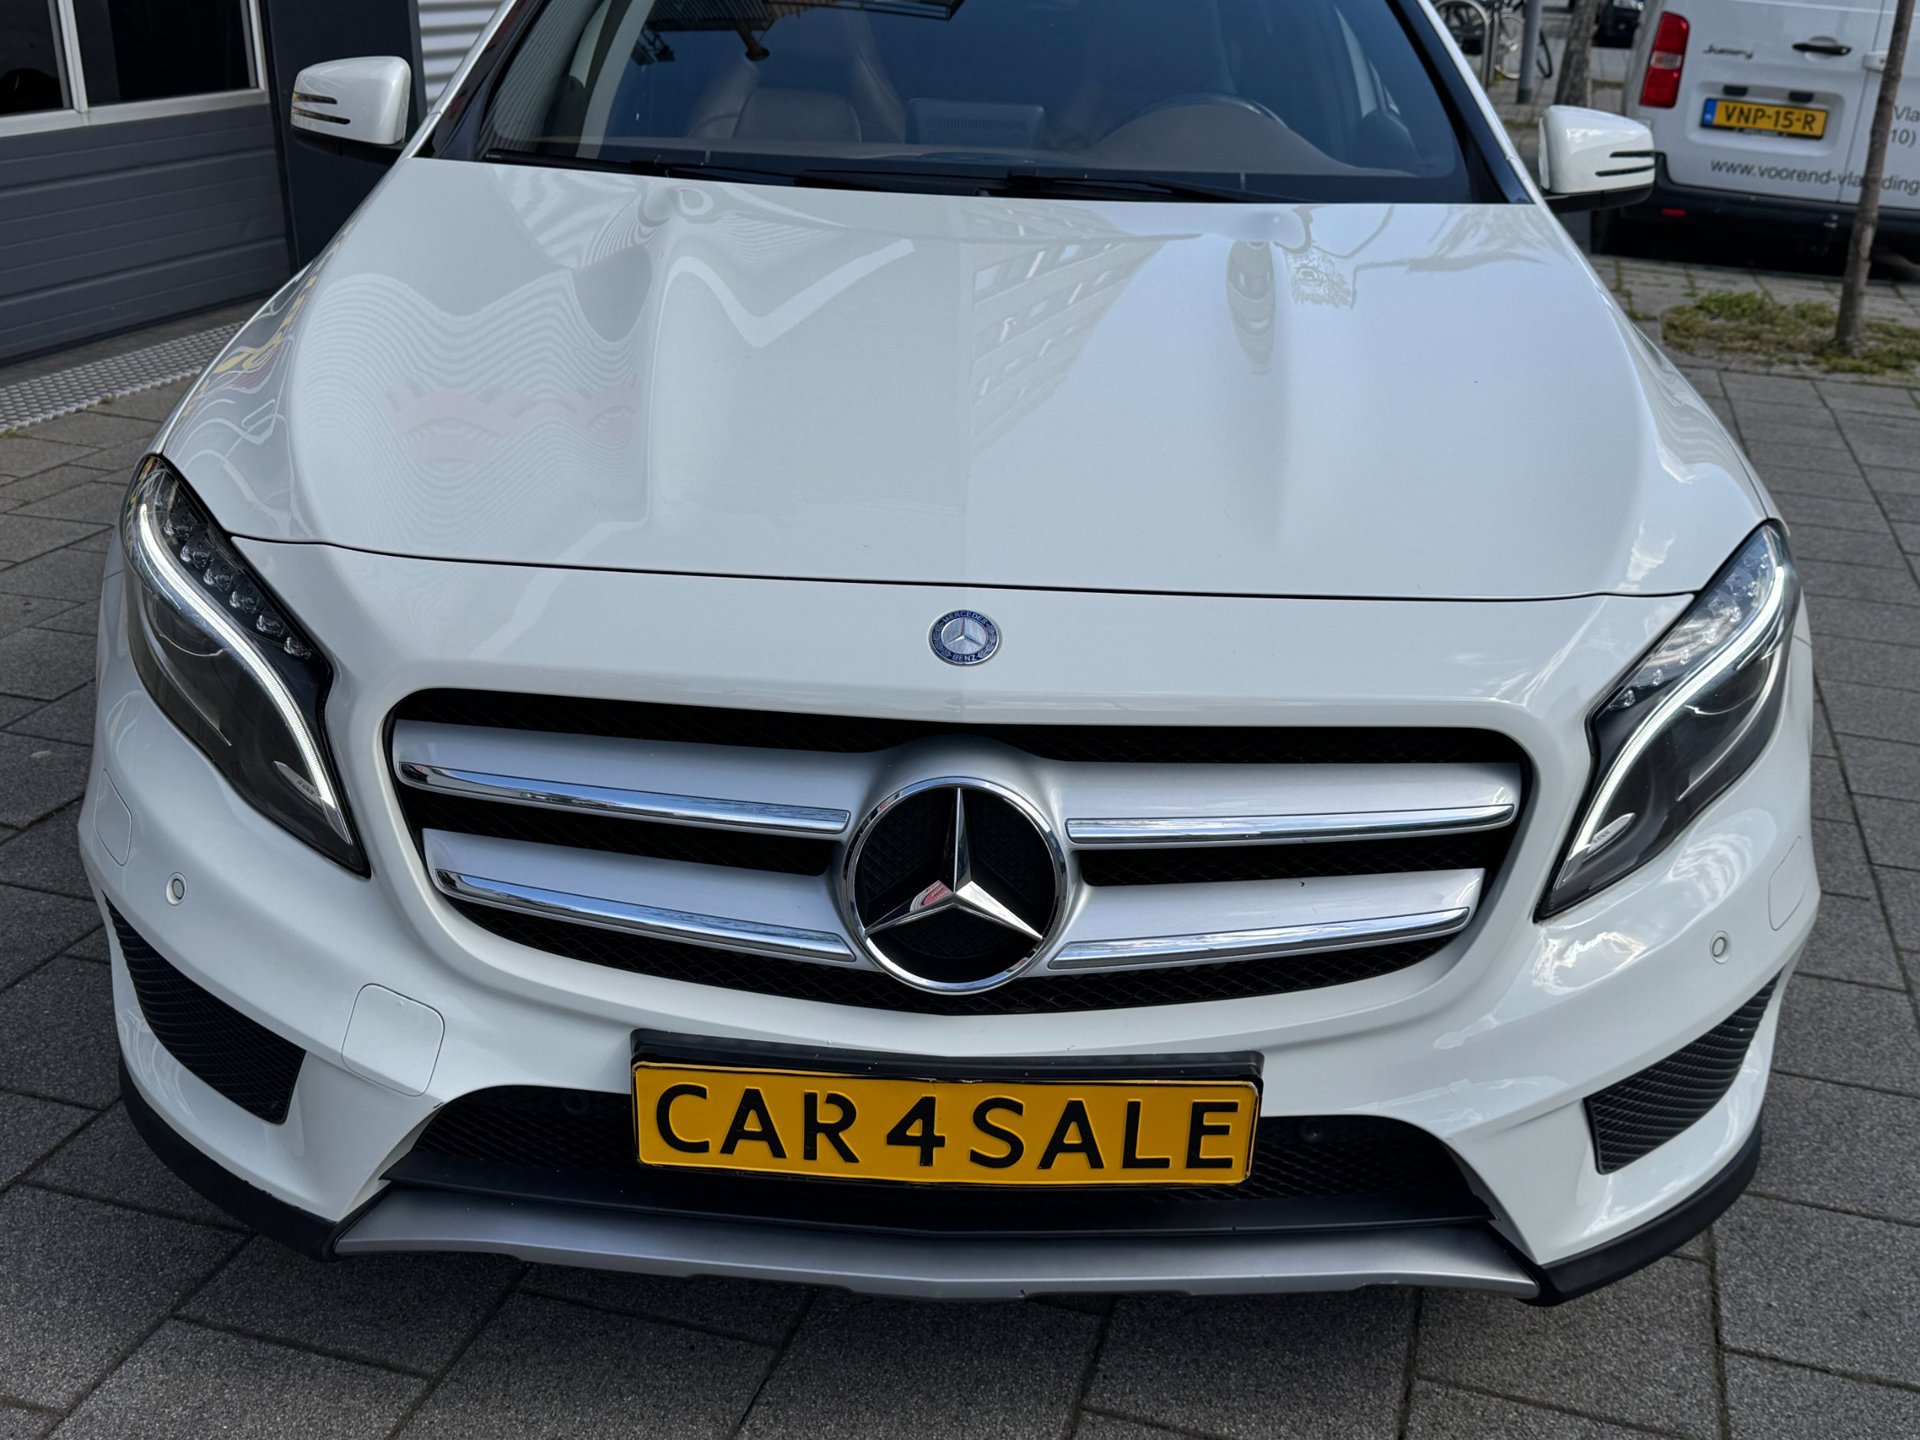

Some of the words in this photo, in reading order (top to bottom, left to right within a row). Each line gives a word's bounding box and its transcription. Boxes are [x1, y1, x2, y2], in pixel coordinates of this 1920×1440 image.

[1724, 105, 1816, 131] VNP-15-R
[1711, 160, 1920, 195] www.voorend-vlading
[942, 610, 988, 624] MERCEDES
[952, 654, 978, 662] BENZ
[656, 1083, 860, 1163] CAR
[885, 1095, 947, 1167] 4
[969, 1097, 1240, 1171] SALE
